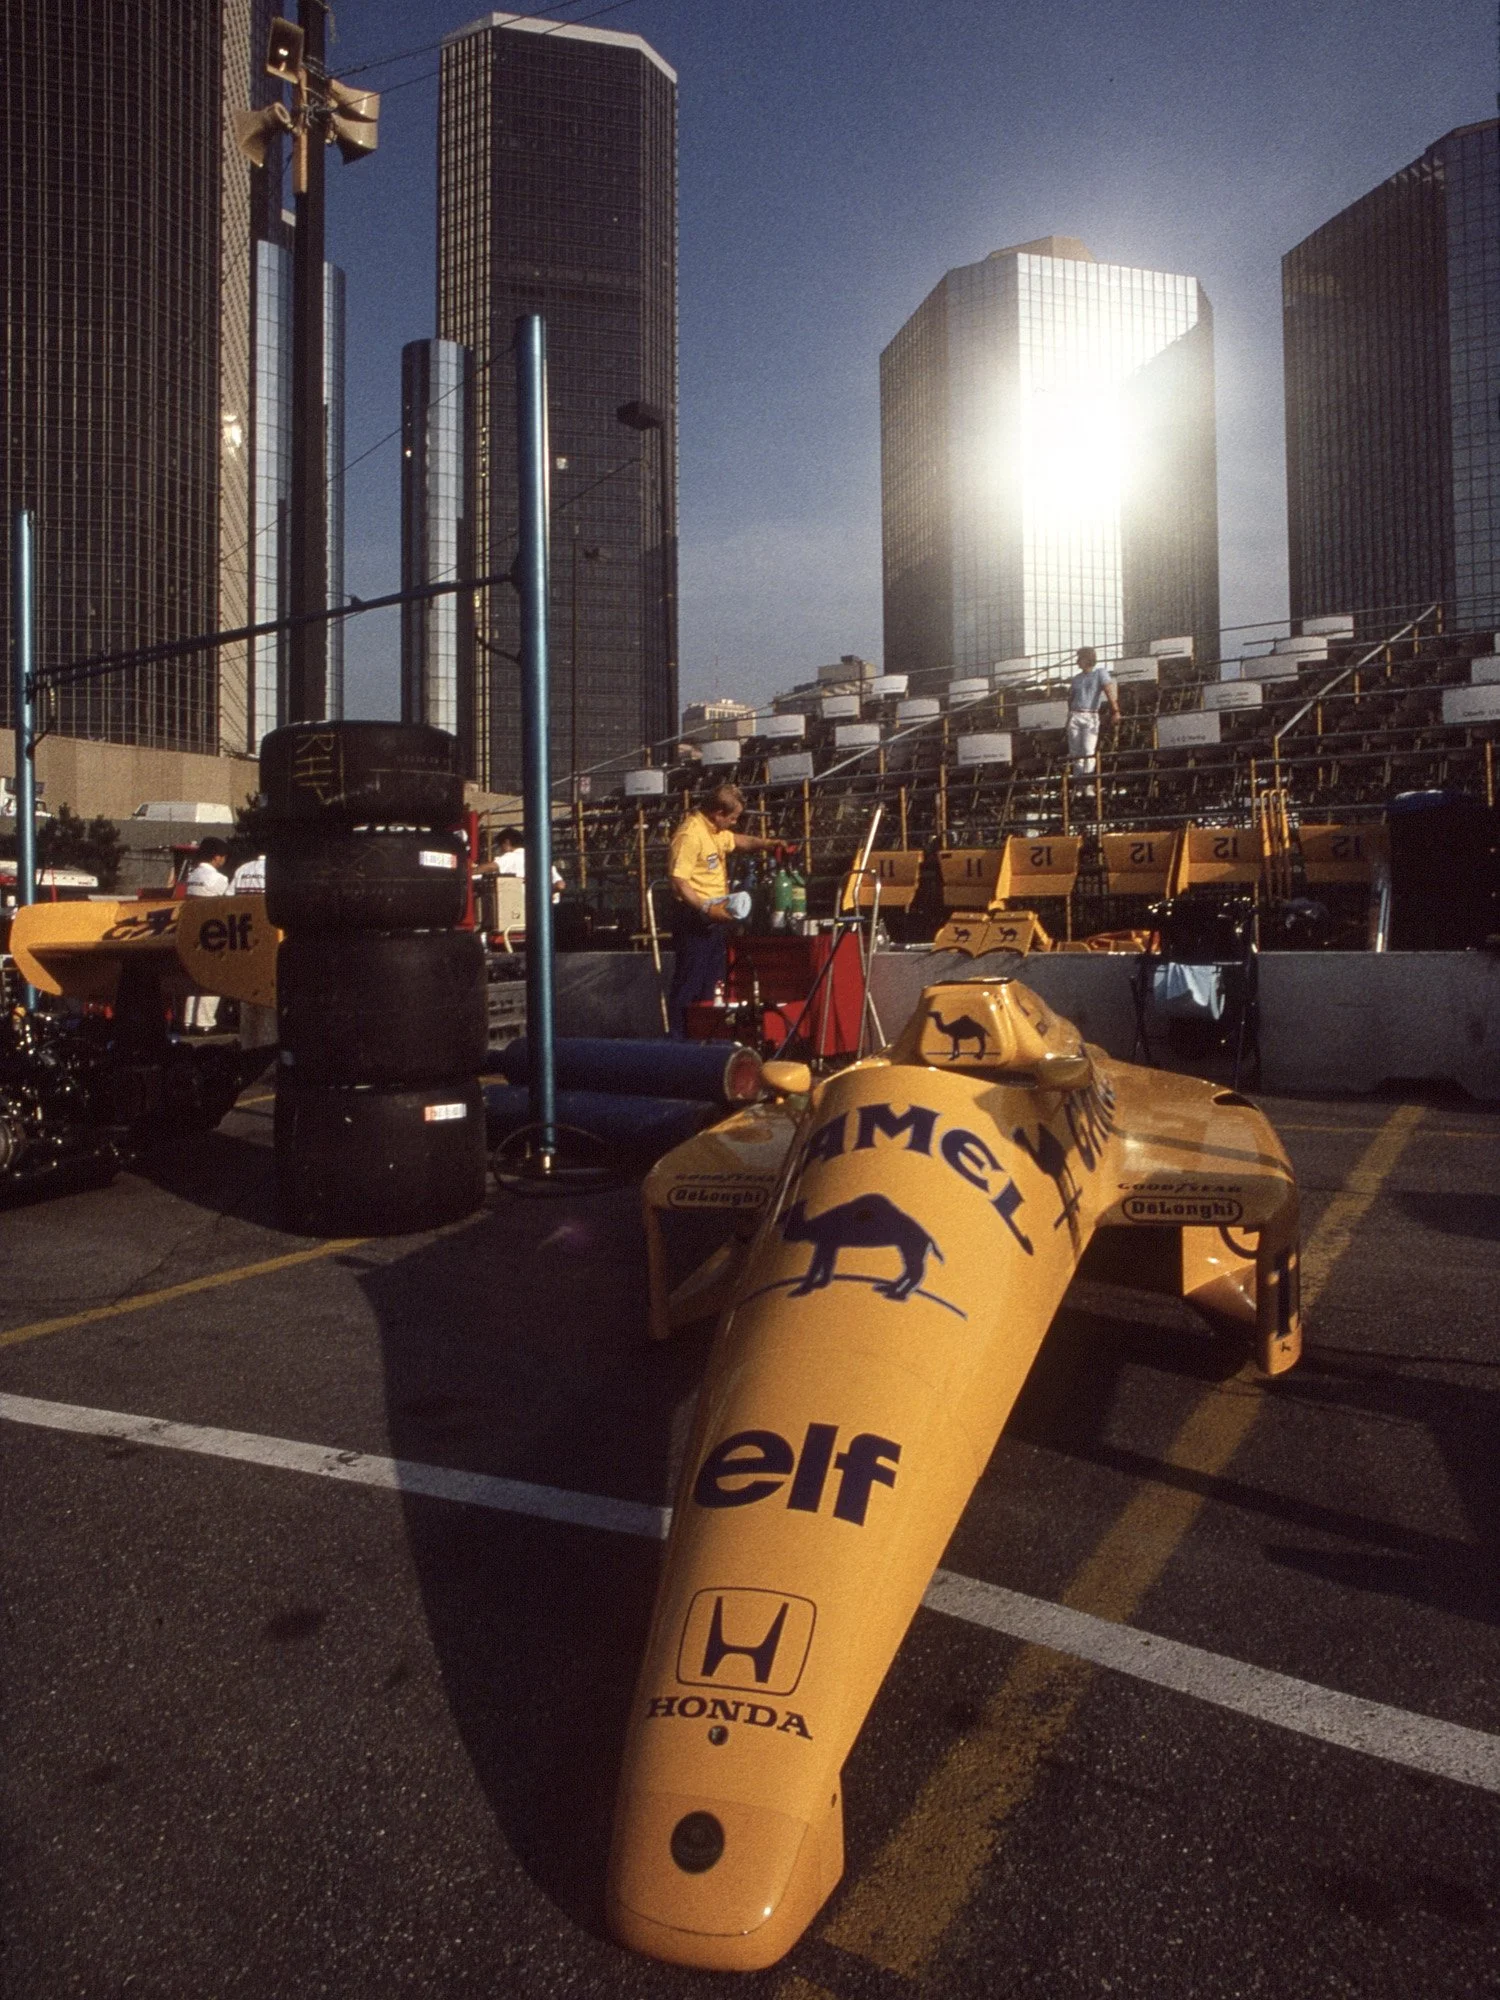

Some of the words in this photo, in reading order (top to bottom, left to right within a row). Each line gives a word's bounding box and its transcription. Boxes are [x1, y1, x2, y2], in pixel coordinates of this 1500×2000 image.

[1030, 846, 1053, 867] 12
[1130, 842, 1154, 864] 12
[1213, 837, 1238, 859] 12
[200, 912, 253, 952] elf
[800, 1103, 1034, 1256] AMEL
[1131, 1201, 1234, 1219] DeLonghi
[694, 1422, 902, 1527] elf
[647, 1696, 813, 1741] HONDA
